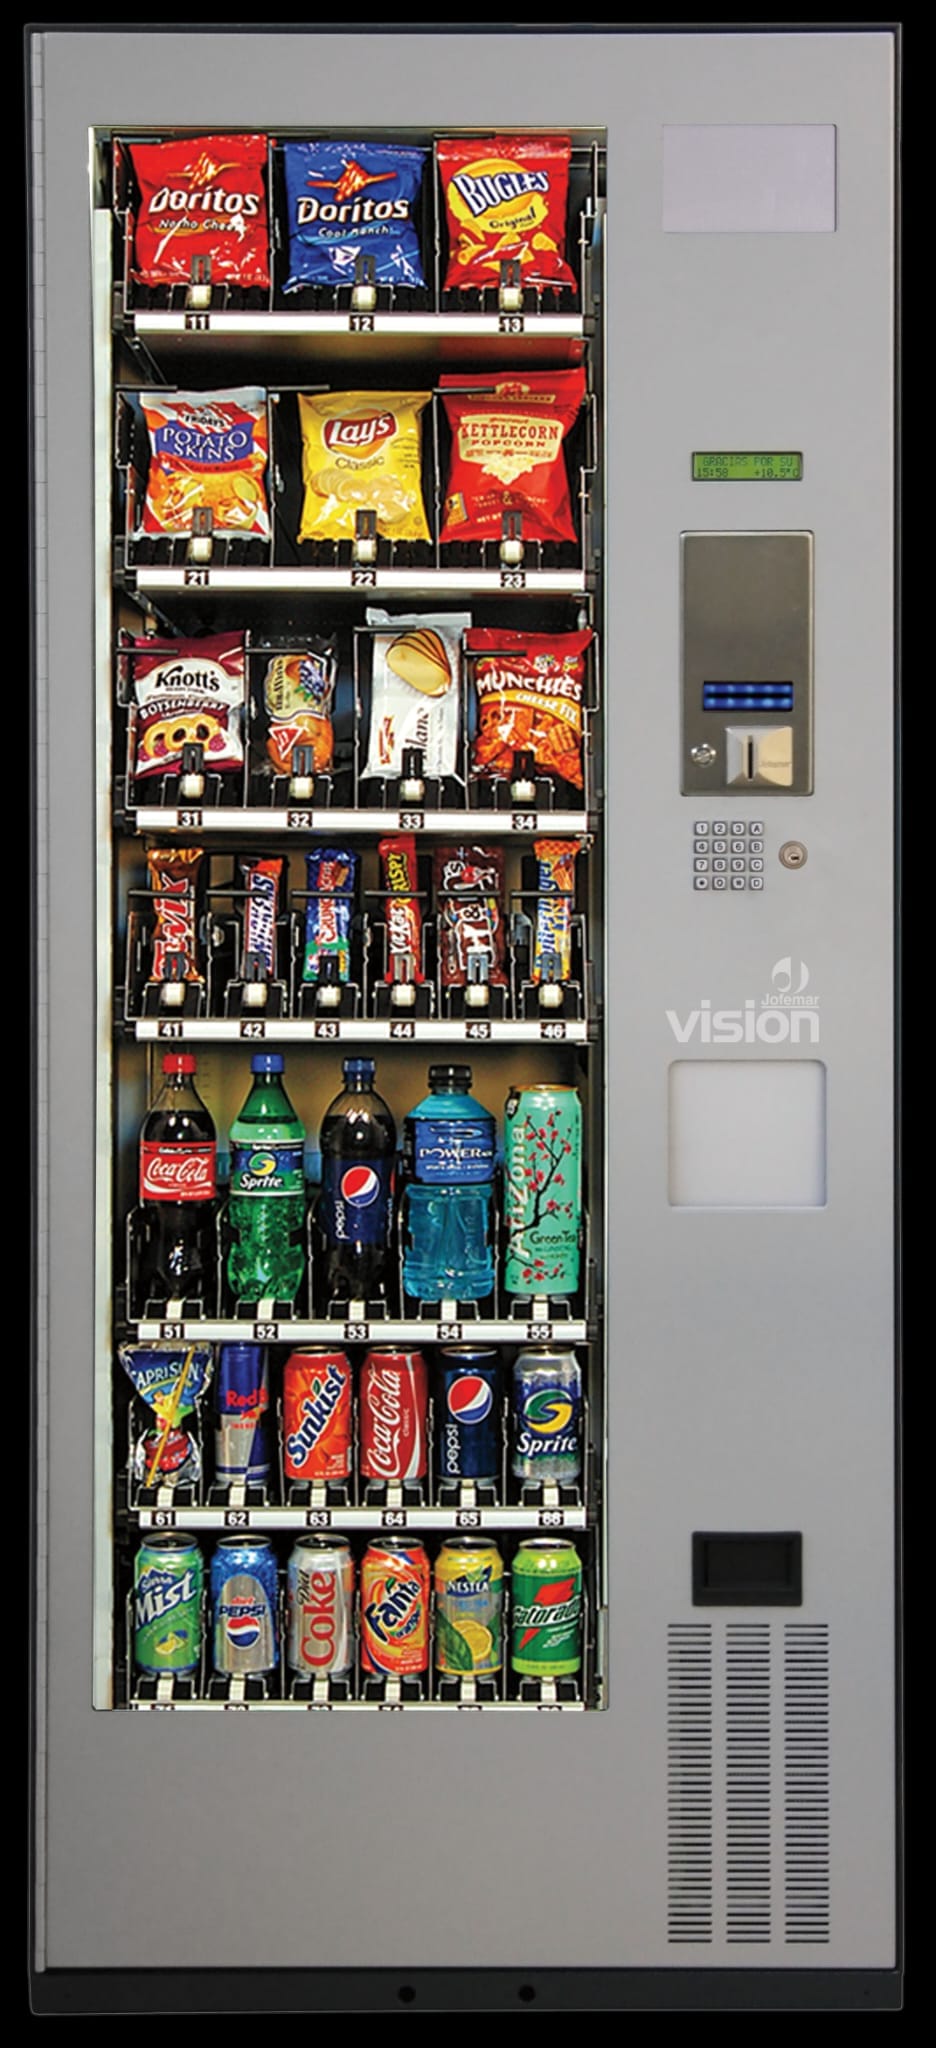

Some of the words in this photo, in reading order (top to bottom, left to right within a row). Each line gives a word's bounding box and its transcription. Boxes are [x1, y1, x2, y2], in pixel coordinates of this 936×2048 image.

[149, 186, 260, 214] Doritos
[453, 171, 549, 217] BUGLES
[297, 196, 409, 224] Doritos
[203, 218, 246, 231] Chee
[489, 207, 536, 229] Original
[190, 317, 206, 329] 11
[353, 318, 371, 330] 12
[503, 319, 521, 332] 13
[163, 428, 248, 448] POTATO
[460, 422, 559, 441] KETTLECORN
[471, 439, 546, 447] POPCORN
[174, 442, 235, 462] SKINS
[335, 457, 385, 471] Classic
[697, 467, 728, 478] 15:58
[188, 573, 205, 585] 21
[355, 573, 374, 586] 22
[504, 574, 523, 588] 23
[155, 666, 220, 692] Knott's
[476, 670, 583, 701] MUNCHIES
[181, 812, 199, 826] 31
[291, 813, 309, 827] 32
[402, 814, 421, 828] 33
[515, 815, 534, 829] 34
[315, 886, 337, 946] CRUNC
[536, 861, 557, 971] utterfiger
[760, 993, 820, 1006] Jofemar
[665, 999, 820, 1043] vision
[162, 1023, 180, 1037] 41
[243, 1023, 263, 1037] 42
[318, 1024, 337, 1038] 43
[393, 1024, 412, 1038] 44
[470, 1024, 489, 1038] 45
[544, 1024, 563, 1038] 46
[240, 1173, 282, 1190] Sprite
[335, 1200, 350, 1240] pepsi
[530, 1230, 562, 1244] Green
[164, 1324, 181, 1339] 51
[256, 1324, 275, 1339] 52
[347, 1324, 366, 1339] 53
[440, 1324, 459, 1339] 54
[531, 1324, 549, 1339] 55
[226, 1389, 257, 1408] Red
[287, 1363, 347, 1467] Sunkist
[445, 1423, 461, 1475] pepsi
[517, 1431, 577, 1457] Sprite
[155, 1512, 173, 1526] 61
[227, 1512, 247, 1526] 62
[309, 1512, 328, 1527] 63
[384, 1512, 404, 1526] 64
[459, 1512, 478, 1526] 65
[135, 1570, 197, 1630] Mist
[219, 1603, 267, 1617] PEPSI
[365, 1579, 421, 1643] Fanta
[301, 1571, 337, 1667] Coke
